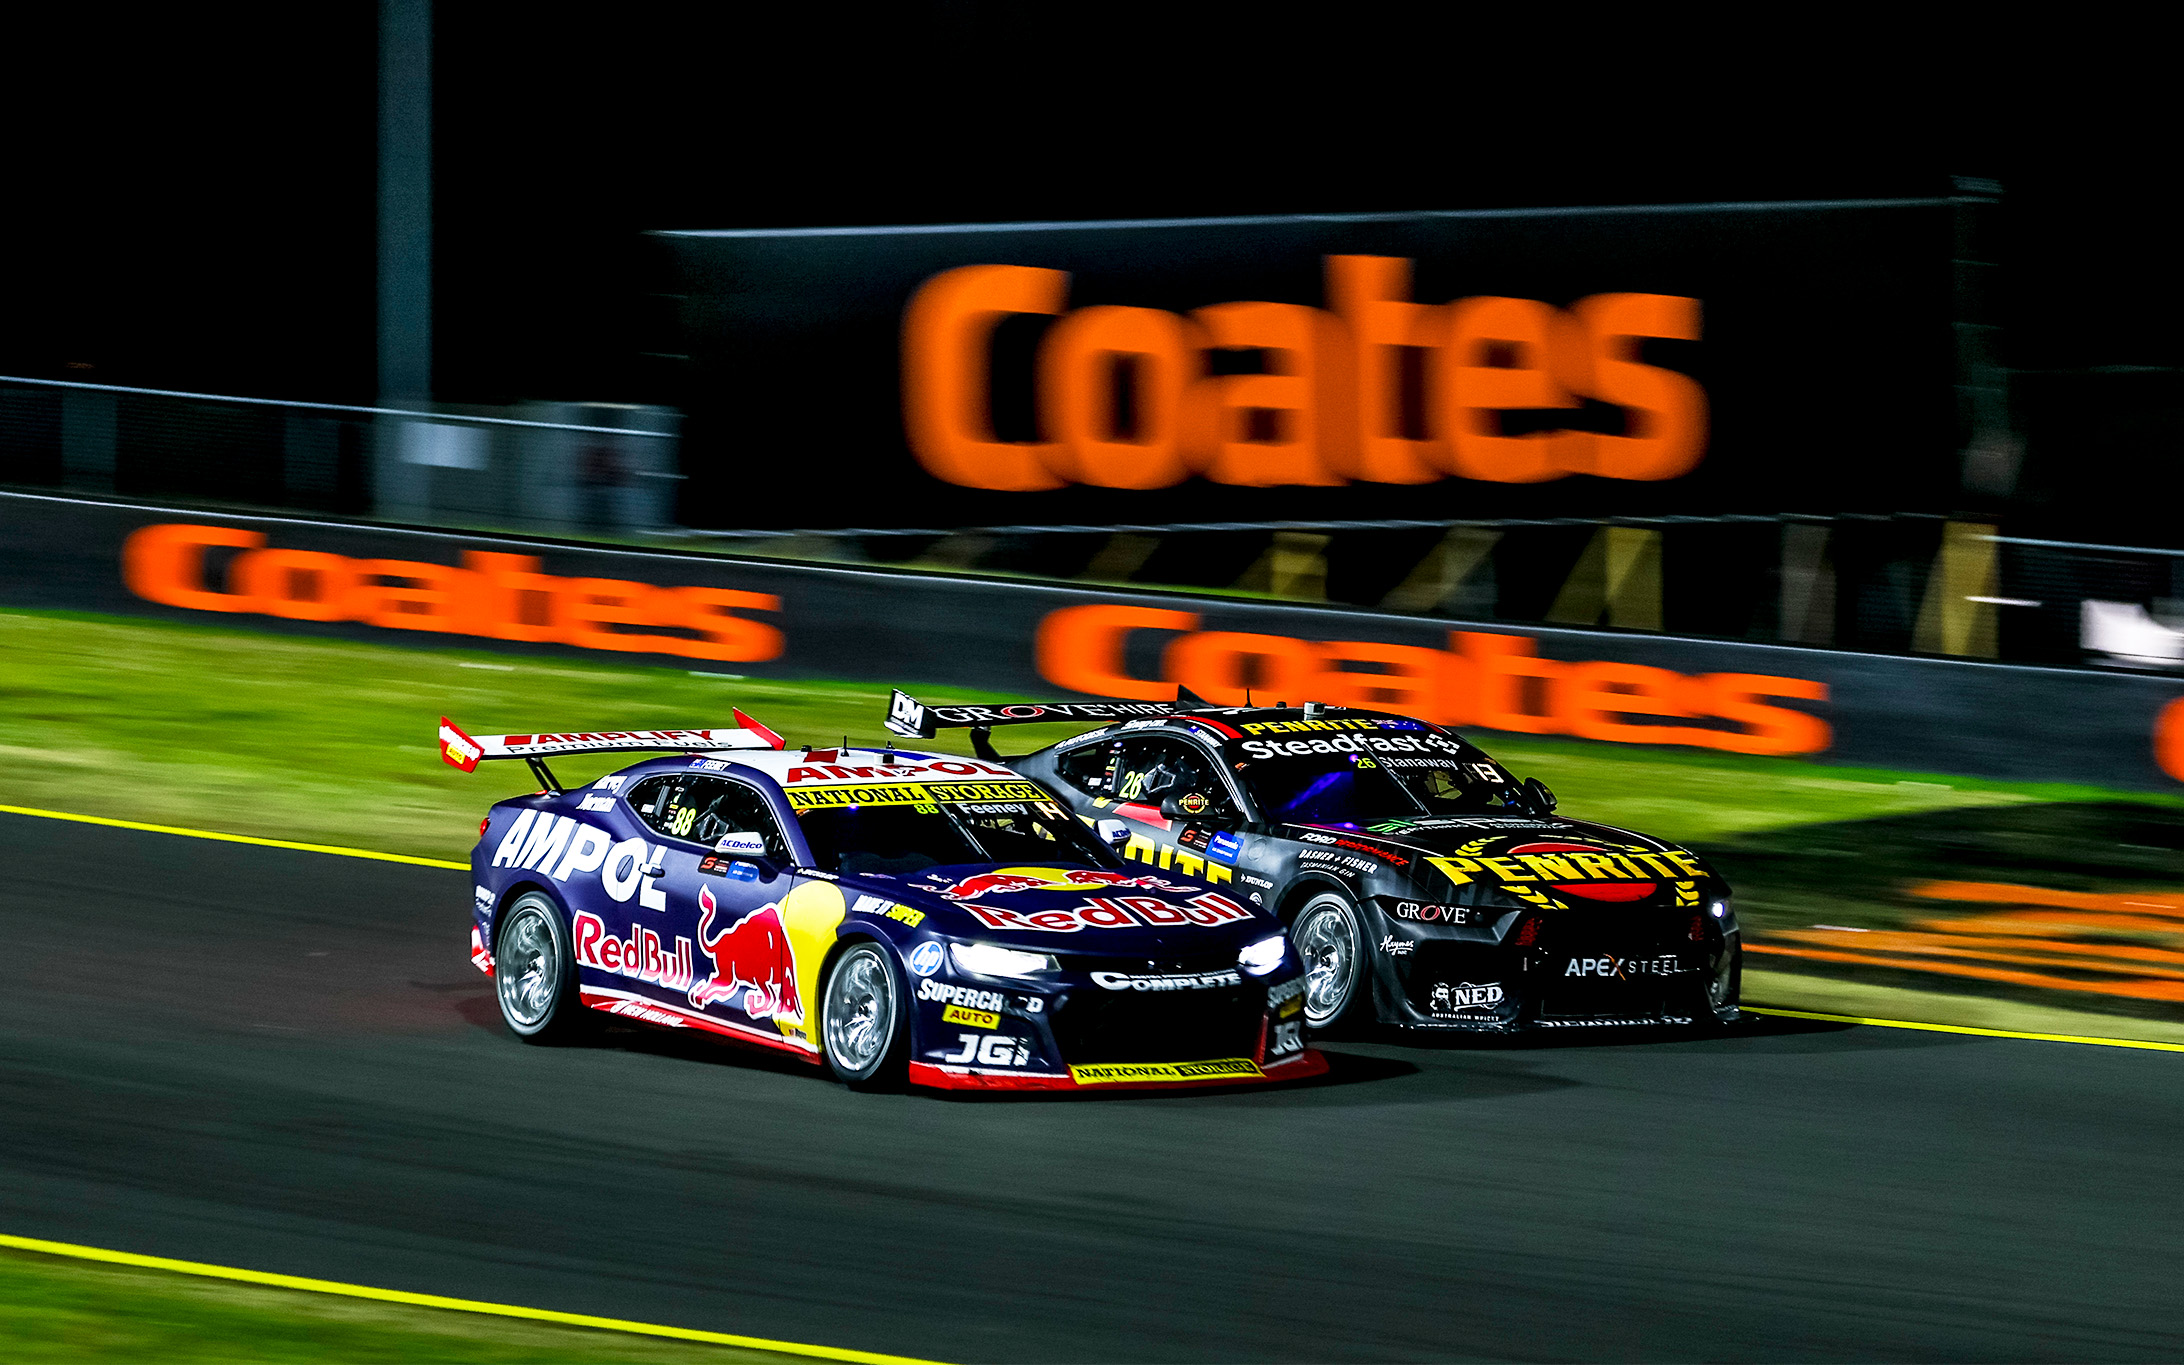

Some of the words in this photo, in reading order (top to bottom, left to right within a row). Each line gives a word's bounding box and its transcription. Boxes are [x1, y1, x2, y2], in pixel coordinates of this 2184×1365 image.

[900, 253, 1709, 491] Coates
[123, 523, 785, 662] Coates
[1036, 605, 1829, 756] Coates
[538, 730, 714, 744] AMPLIFY
[1240, 719, 1378, 736] PENRITE
[1241, 733, 1431, 760] Steadfast
[787, 761, 1014, 783] AMPOL
[1357, 757, 1377, 769] 26
[1379, 756, 1459, 771] Stanaway
[788, 786, 925, 807] NATIONAL
[929, 784, 1041, 801] STORAGE
[1118, 771, 1145, 800] 26
[914, 803, 940, 815] 88
[955, 802, 1029, 815] Feeney
[671, 806, 697, 836] 88
[719, 839, 763, 850] ACDelco
[1299, 833, 1337, 845] FORD
[492, 808, 668, 912] AMPOL
[1298, 849, 1335, 862] DASHER
[1341, 856, 1379, 875] FISHER
[1424, 850, 1710, 885] PENRITE
[1246, 875, 1274, 890] DUNLOP
[954, 898, 1144, 933] Red
[1113, 892, 1256, 926] Bull
[1396, 902, 1467, 924] GROVE
[573, 909, 642, 978] Red
[641, 928, 693, 992] Bull
[1565, 953, 1627, 980] APEX
[1629, 960, 1681, 973] STEEL
[1090, 972, 1242, 992] COMPLETE
[1454, 987, 1504, 1005] NED
[950, 1010, 994, 1024] AUTO
[1078, 1065, 1176, 1078] NATIONAL
[1182, 1060, 1256, 1075] STORAGE
